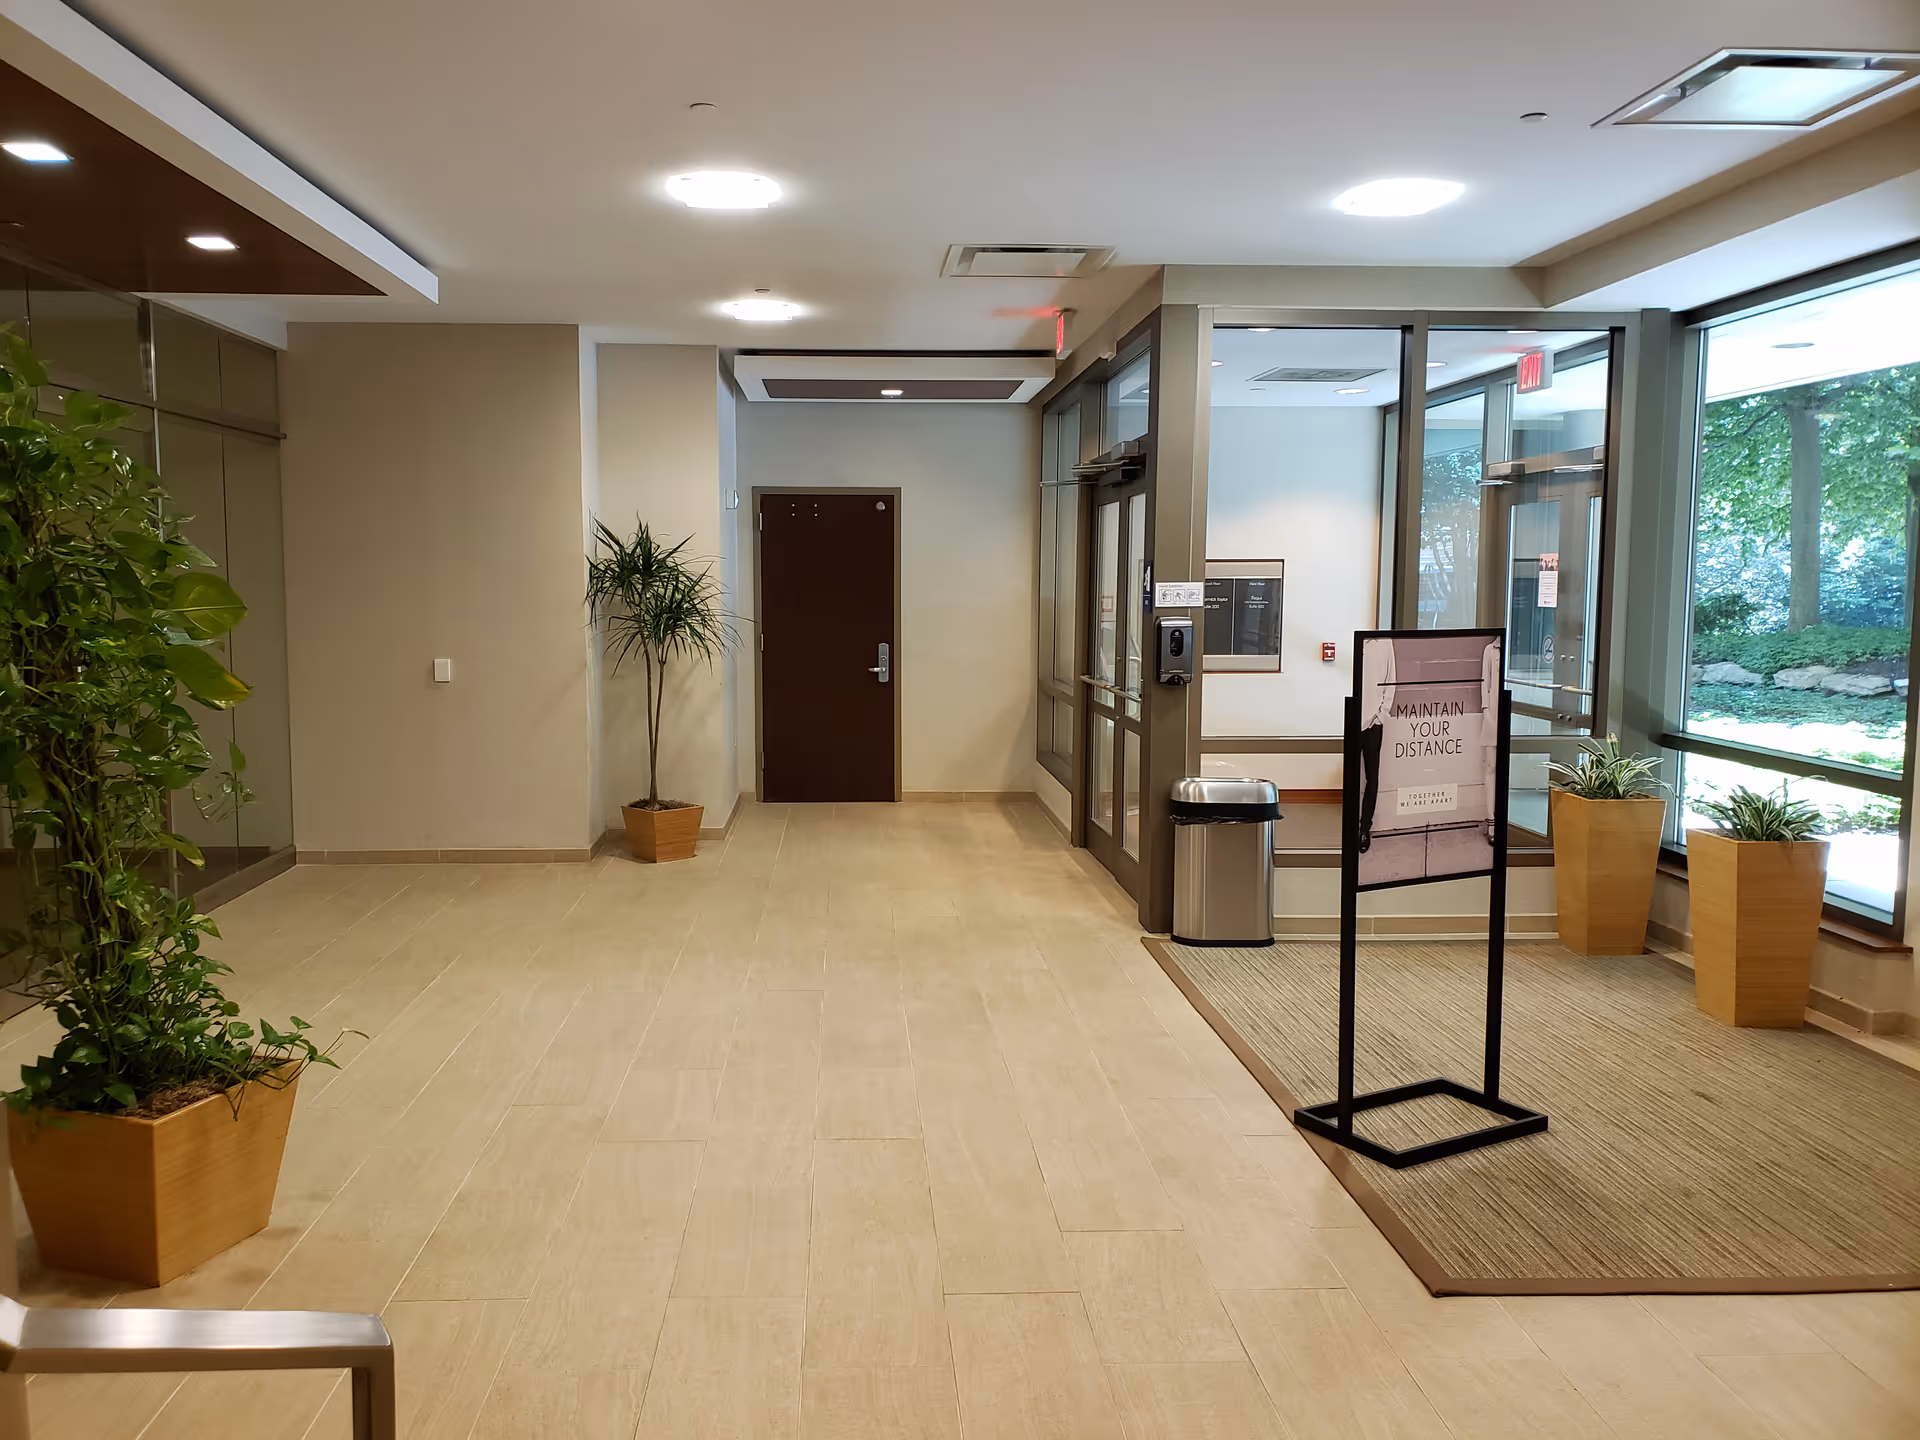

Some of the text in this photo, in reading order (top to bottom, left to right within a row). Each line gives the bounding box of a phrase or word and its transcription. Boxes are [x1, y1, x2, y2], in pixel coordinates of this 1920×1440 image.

[1521, 352, 1543, 390] EXIT
[1396, 701, 1464, 720] MAINTAIN
[1410, 721, 1450, 738] YOUR
[1395, 739, 1463, 758] DISTANCE
[1408, 791, 1445, 800] TOGETHER
[1431, 797, 1453, 805] APART
